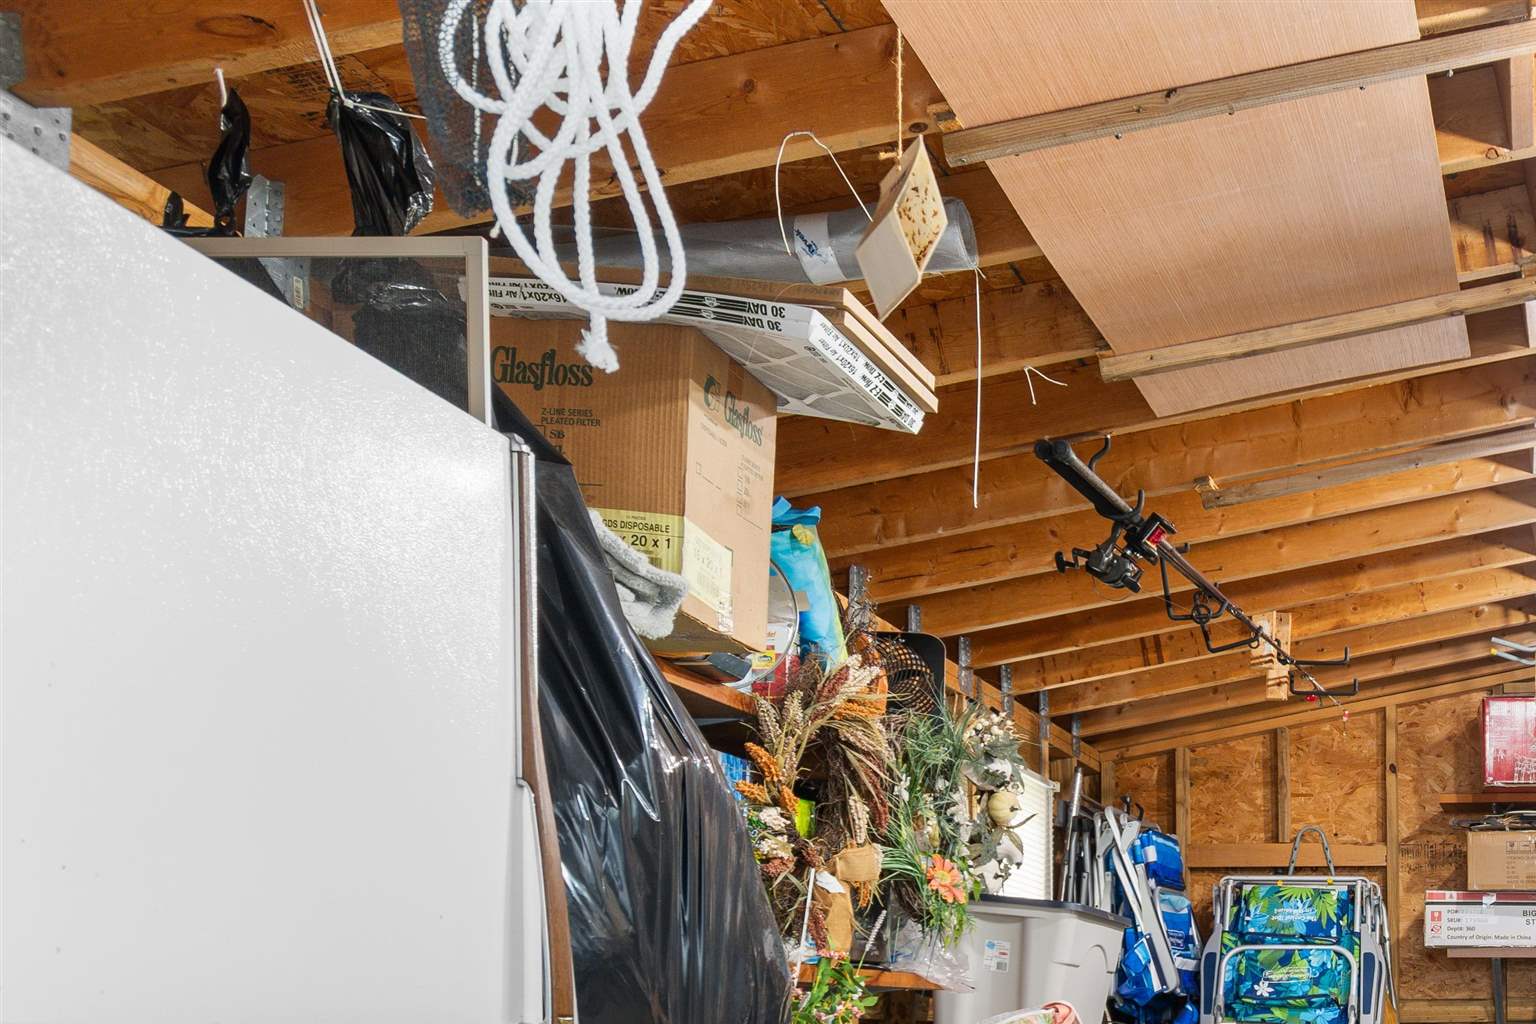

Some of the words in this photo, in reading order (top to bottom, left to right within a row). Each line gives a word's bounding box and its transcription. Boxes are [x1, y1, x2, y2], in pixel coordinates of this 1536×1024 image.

[521, 291, 567, 303] 16x20x1
[746, 301, 768, 315] DAY
[771, 305, 786, 318] 30
[743, 315, 765, 329] DAY
[768, 319, 782, 332] 30
[490, 345, 594, 391] Glasfloss
[541, 407, 566, 417] Z-LINE
[567, 408, 593, 417] SERIES
[724, 390, 764, 447] Glasfloss
[541, 417, 575, 426] PLEATED
[575, 418, 601, 427] FILTER
[620, 520, 671, 534] DISPOSABLE
[630, 534, 648, 547] 20
